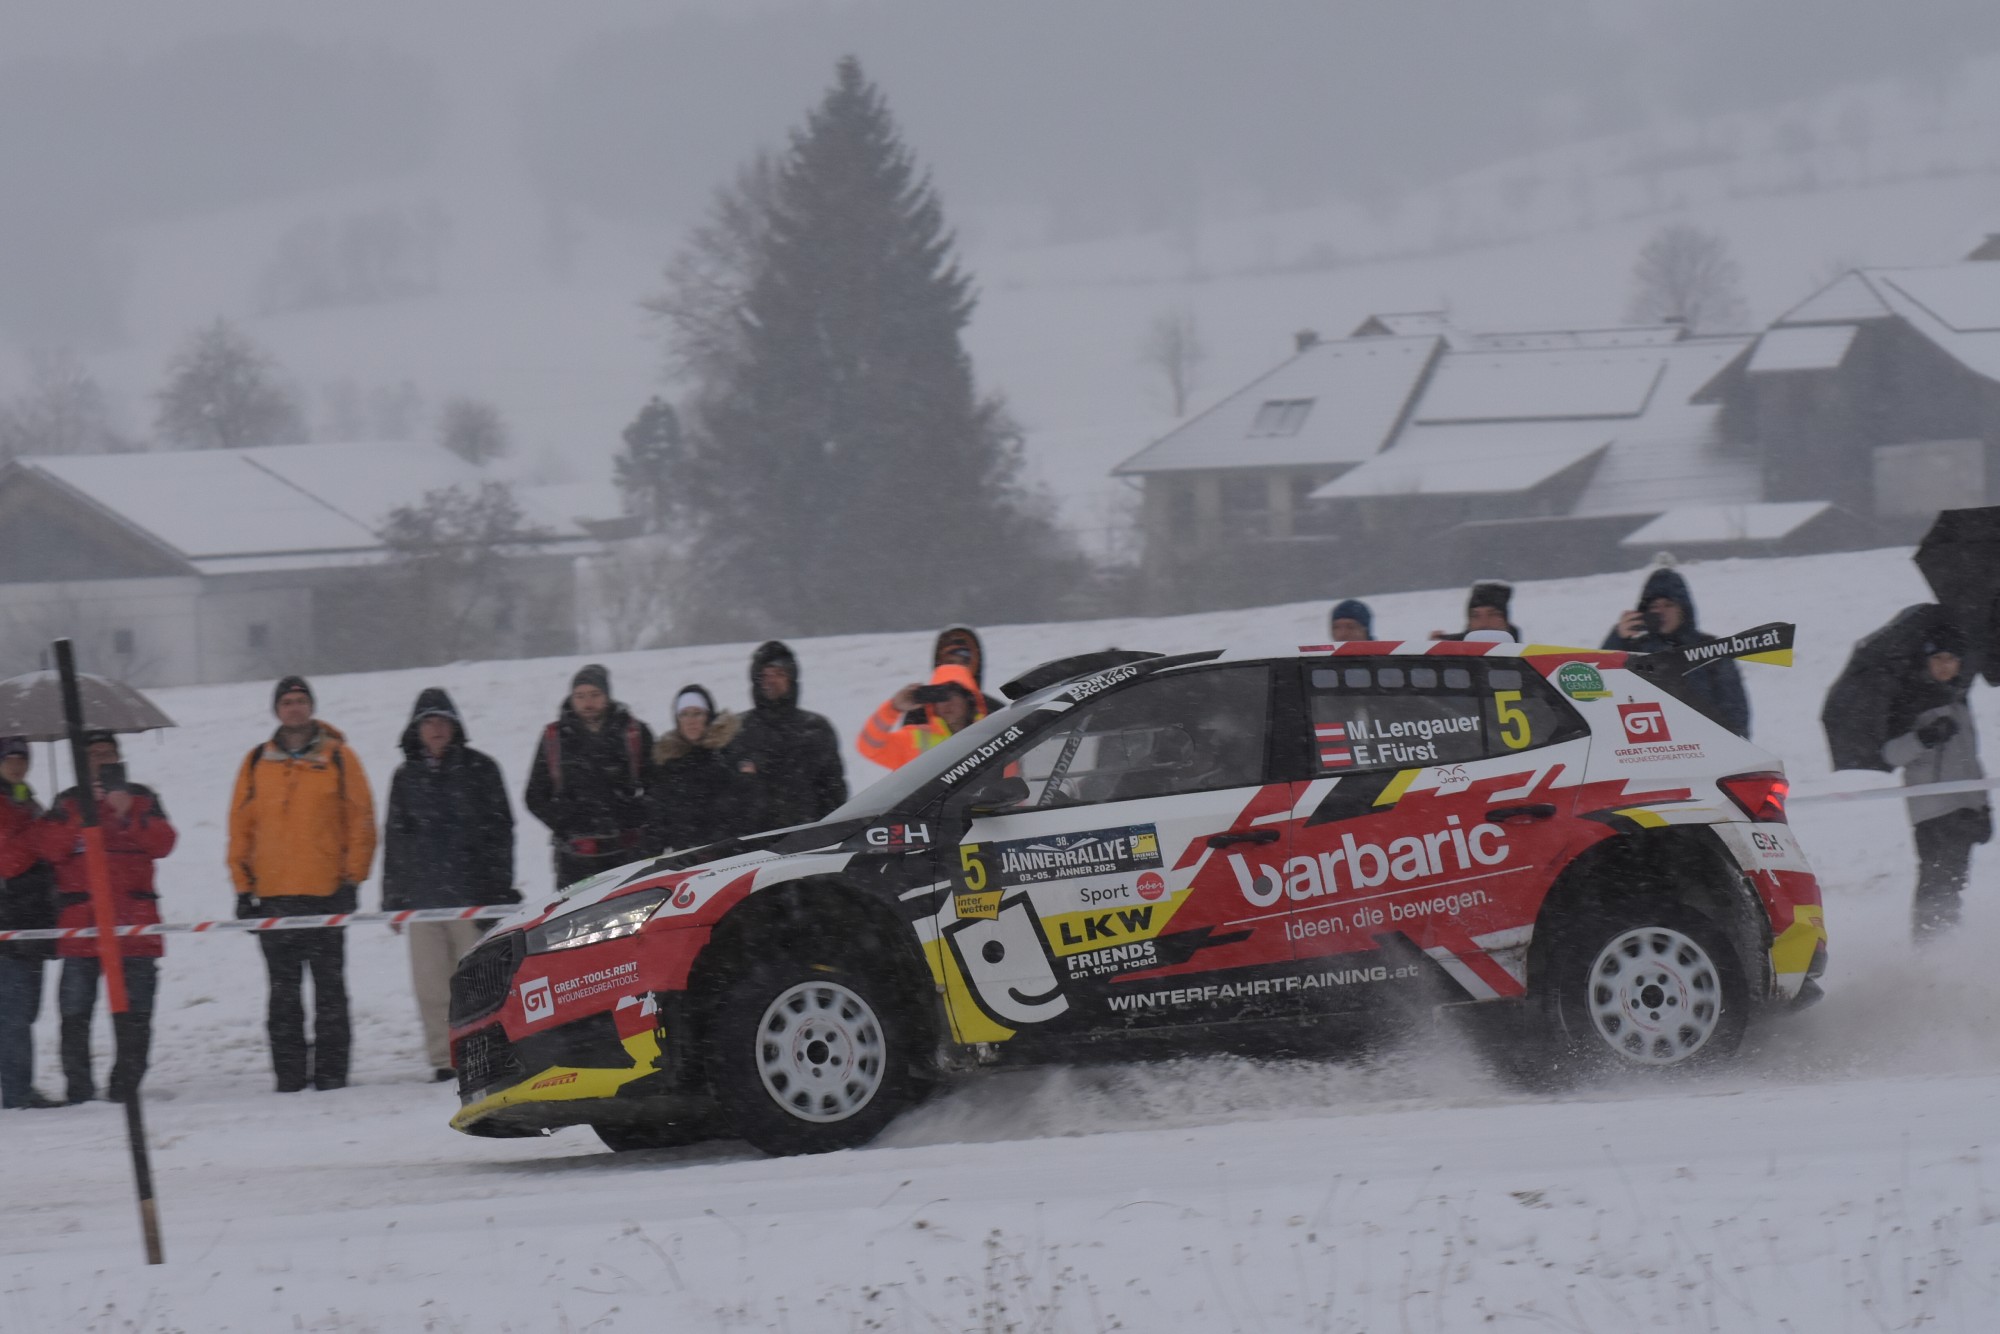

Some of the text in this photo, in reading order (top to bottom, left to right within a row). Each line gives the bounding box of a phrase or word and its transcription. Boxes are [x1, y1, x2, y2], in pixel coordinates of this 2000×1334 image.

[1683, 629, 1781, 662] www.brr.at
[1066, 675, 1107, 696] DOM
[1073, 667, 1138, 702] EXCLUSIV
[1560, 673, 1592, 682] HOCH
[1566, 681, 1601, 690] GENUSS
[1494, 690, 1532, 749] 5
[1624, 710, 1662, 735] GT
[940, 725, 1024, 785] www.brr.at
[1614, 743, 1701, 757] GREAT-TOOLS.RENT
[1618, 751, 1705, 764] #YOUNEEDGREATTOOLS
[1056, 836, 1070, 847] 38.
[959, 843, 988, 891] 5
[1001, 837, 1128, 874] JÄNNERRALLYE
[1227, 815, 1510, 908] barbaric
[1019, 863, 1117, 883] 03.-05. JÄNNER 2025
[1138, 880, 1164, 891] ober
[957, 895, 982, 907] inter
[1080, 883, 1130, 905] Sport
[960, 903, 996, 914] wetten
[1284, 889, 1493, 941] Ideen, die bewegen.
[1059, 906, 1153, 946] LKW
[1067, 941, 1156, 971] FRIENDS
[1070, 955, 1158, 980] on the road
[554, 961, 638, 994] GREAT-TOOLS.RENT
[557, 972, 640, 1004] #YOUNEEDGREATTOOLS
[1108, 964, 1419, 1012] WINTERFAHRTRAINING.at
[525, 986, 549, 1012] GT
[531, 1072, 578, 1090] PIRELLI
